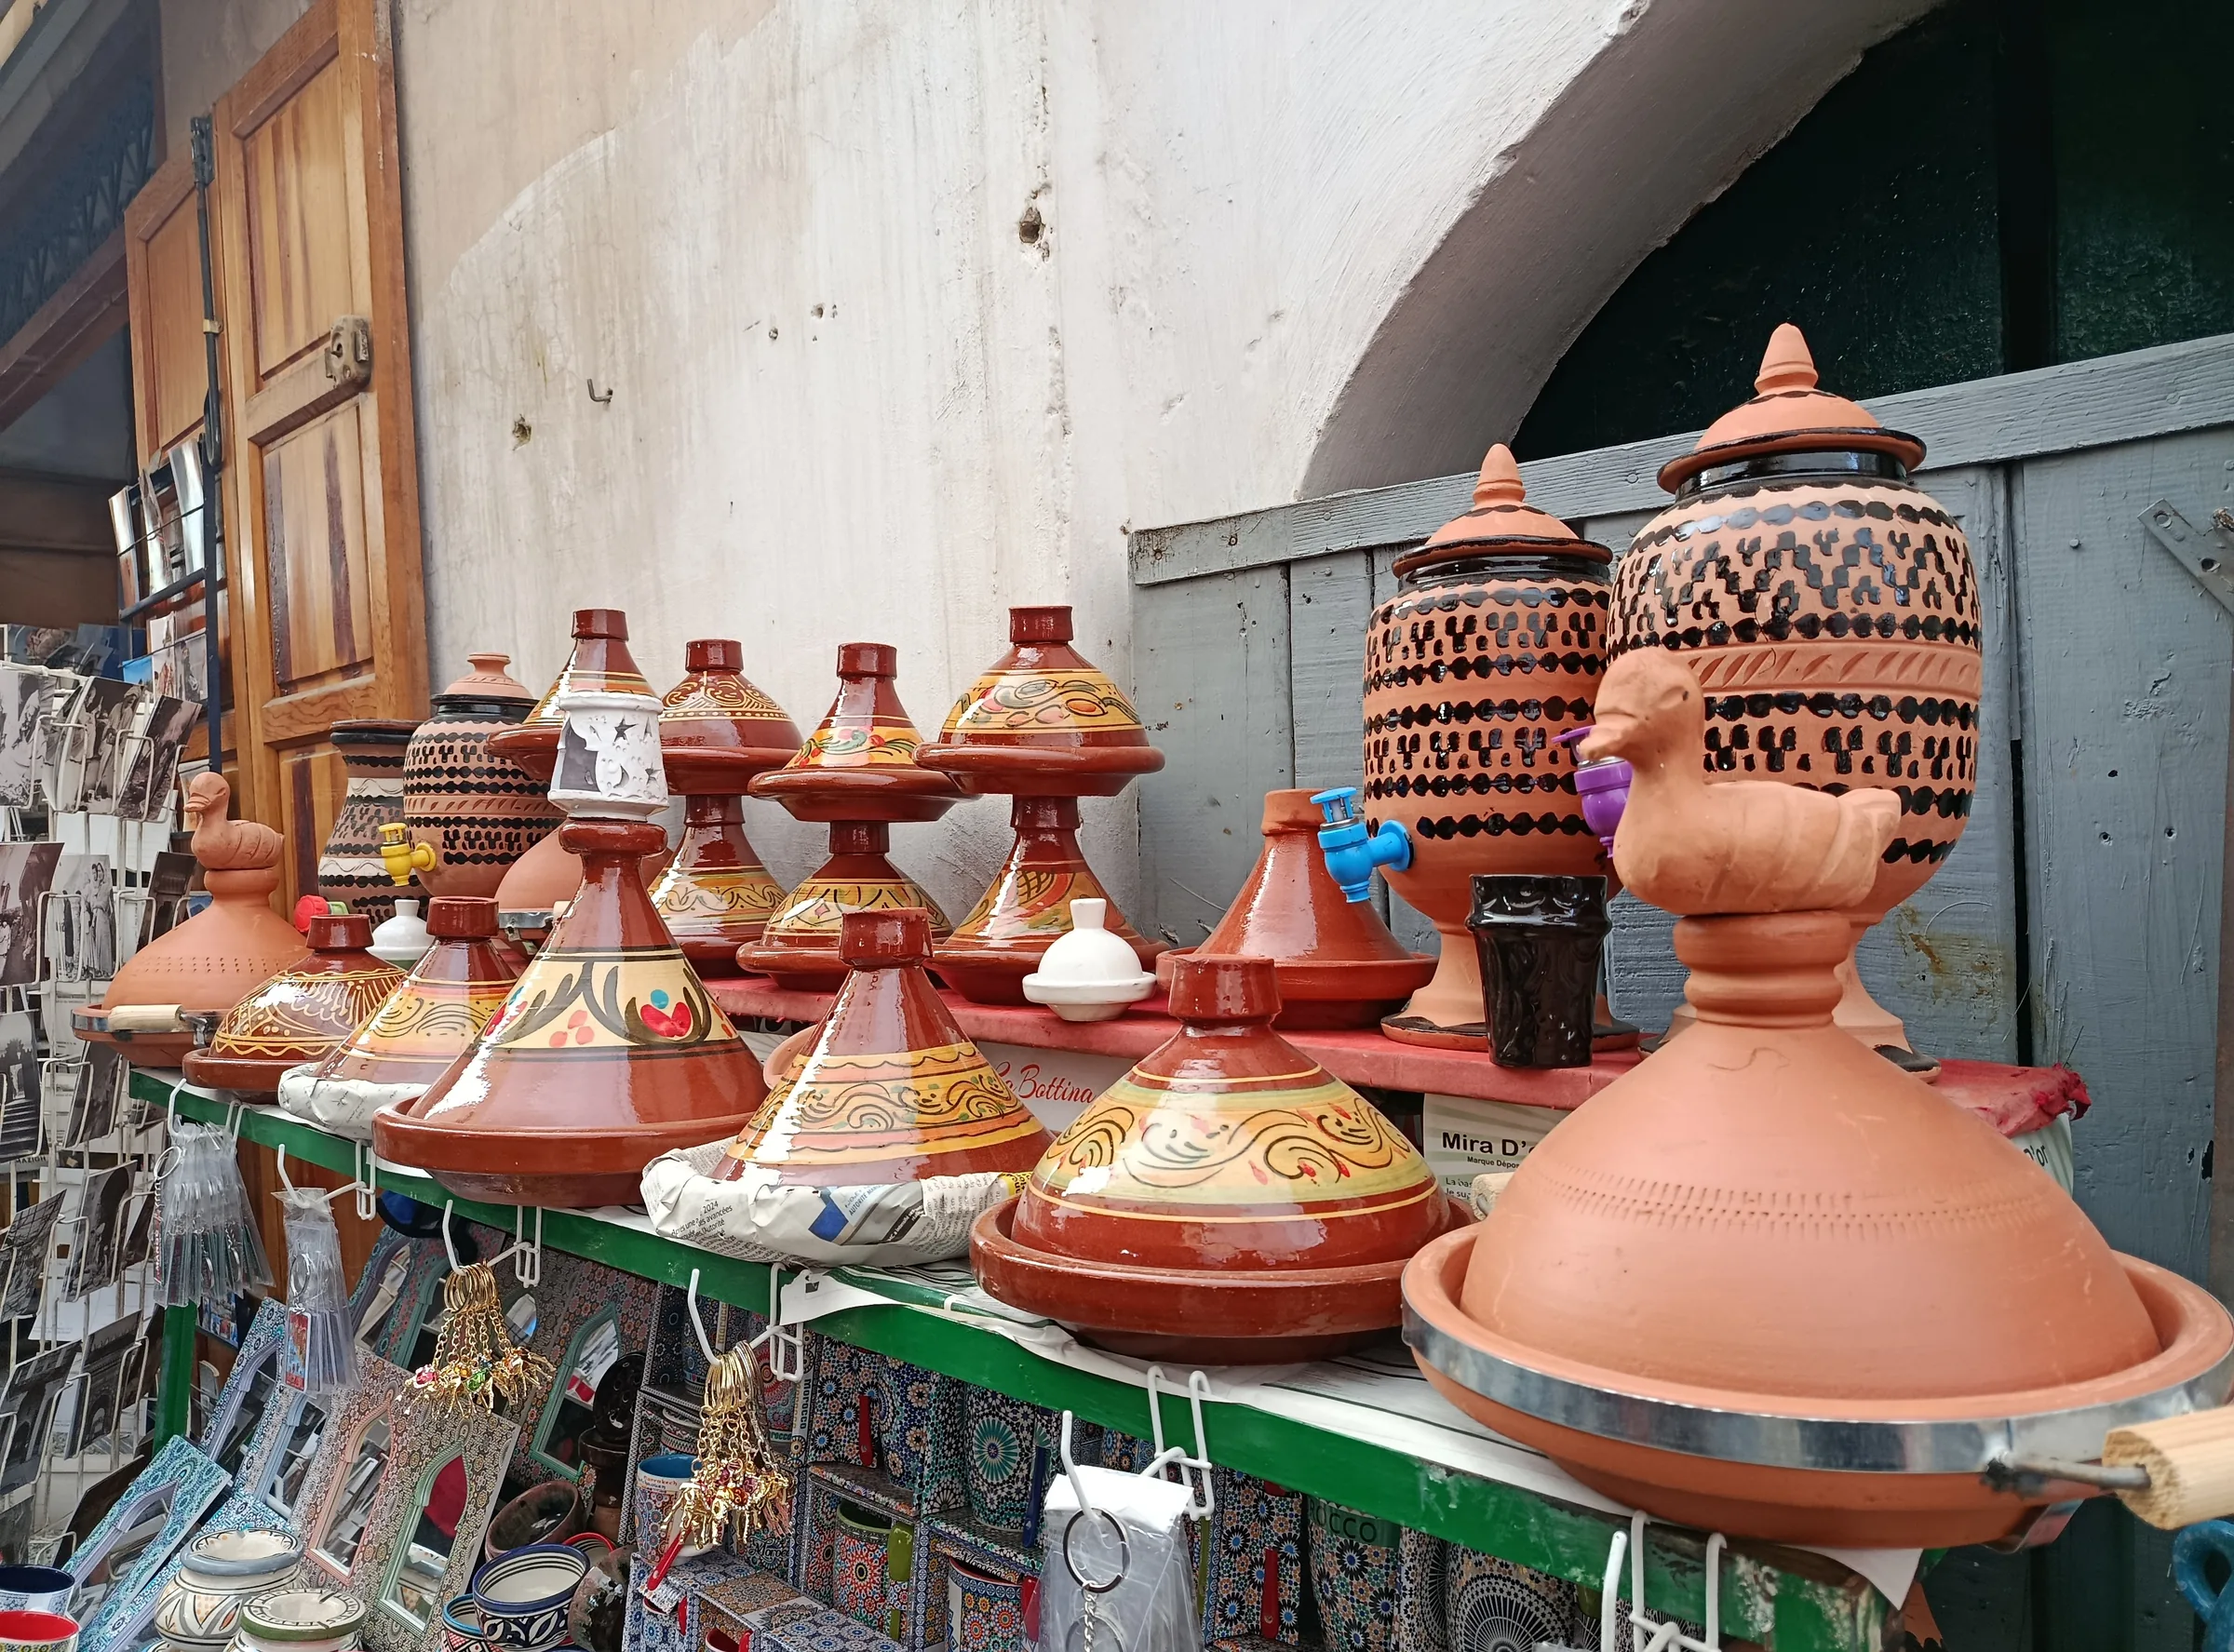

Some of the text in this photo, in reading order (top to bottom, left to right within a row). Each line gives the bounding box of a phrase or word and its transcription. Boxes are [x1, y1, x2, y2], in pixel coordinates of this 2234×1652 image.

[1018, 1064, 1096, 1104] Bottina
[1442, 1132, 1493, 1154] Mira
[1467, 1156, 1495, 1167] Marque
[703, 1201, 719, 1214] 2024
[800, 1378, 812, 1430] Morocco
